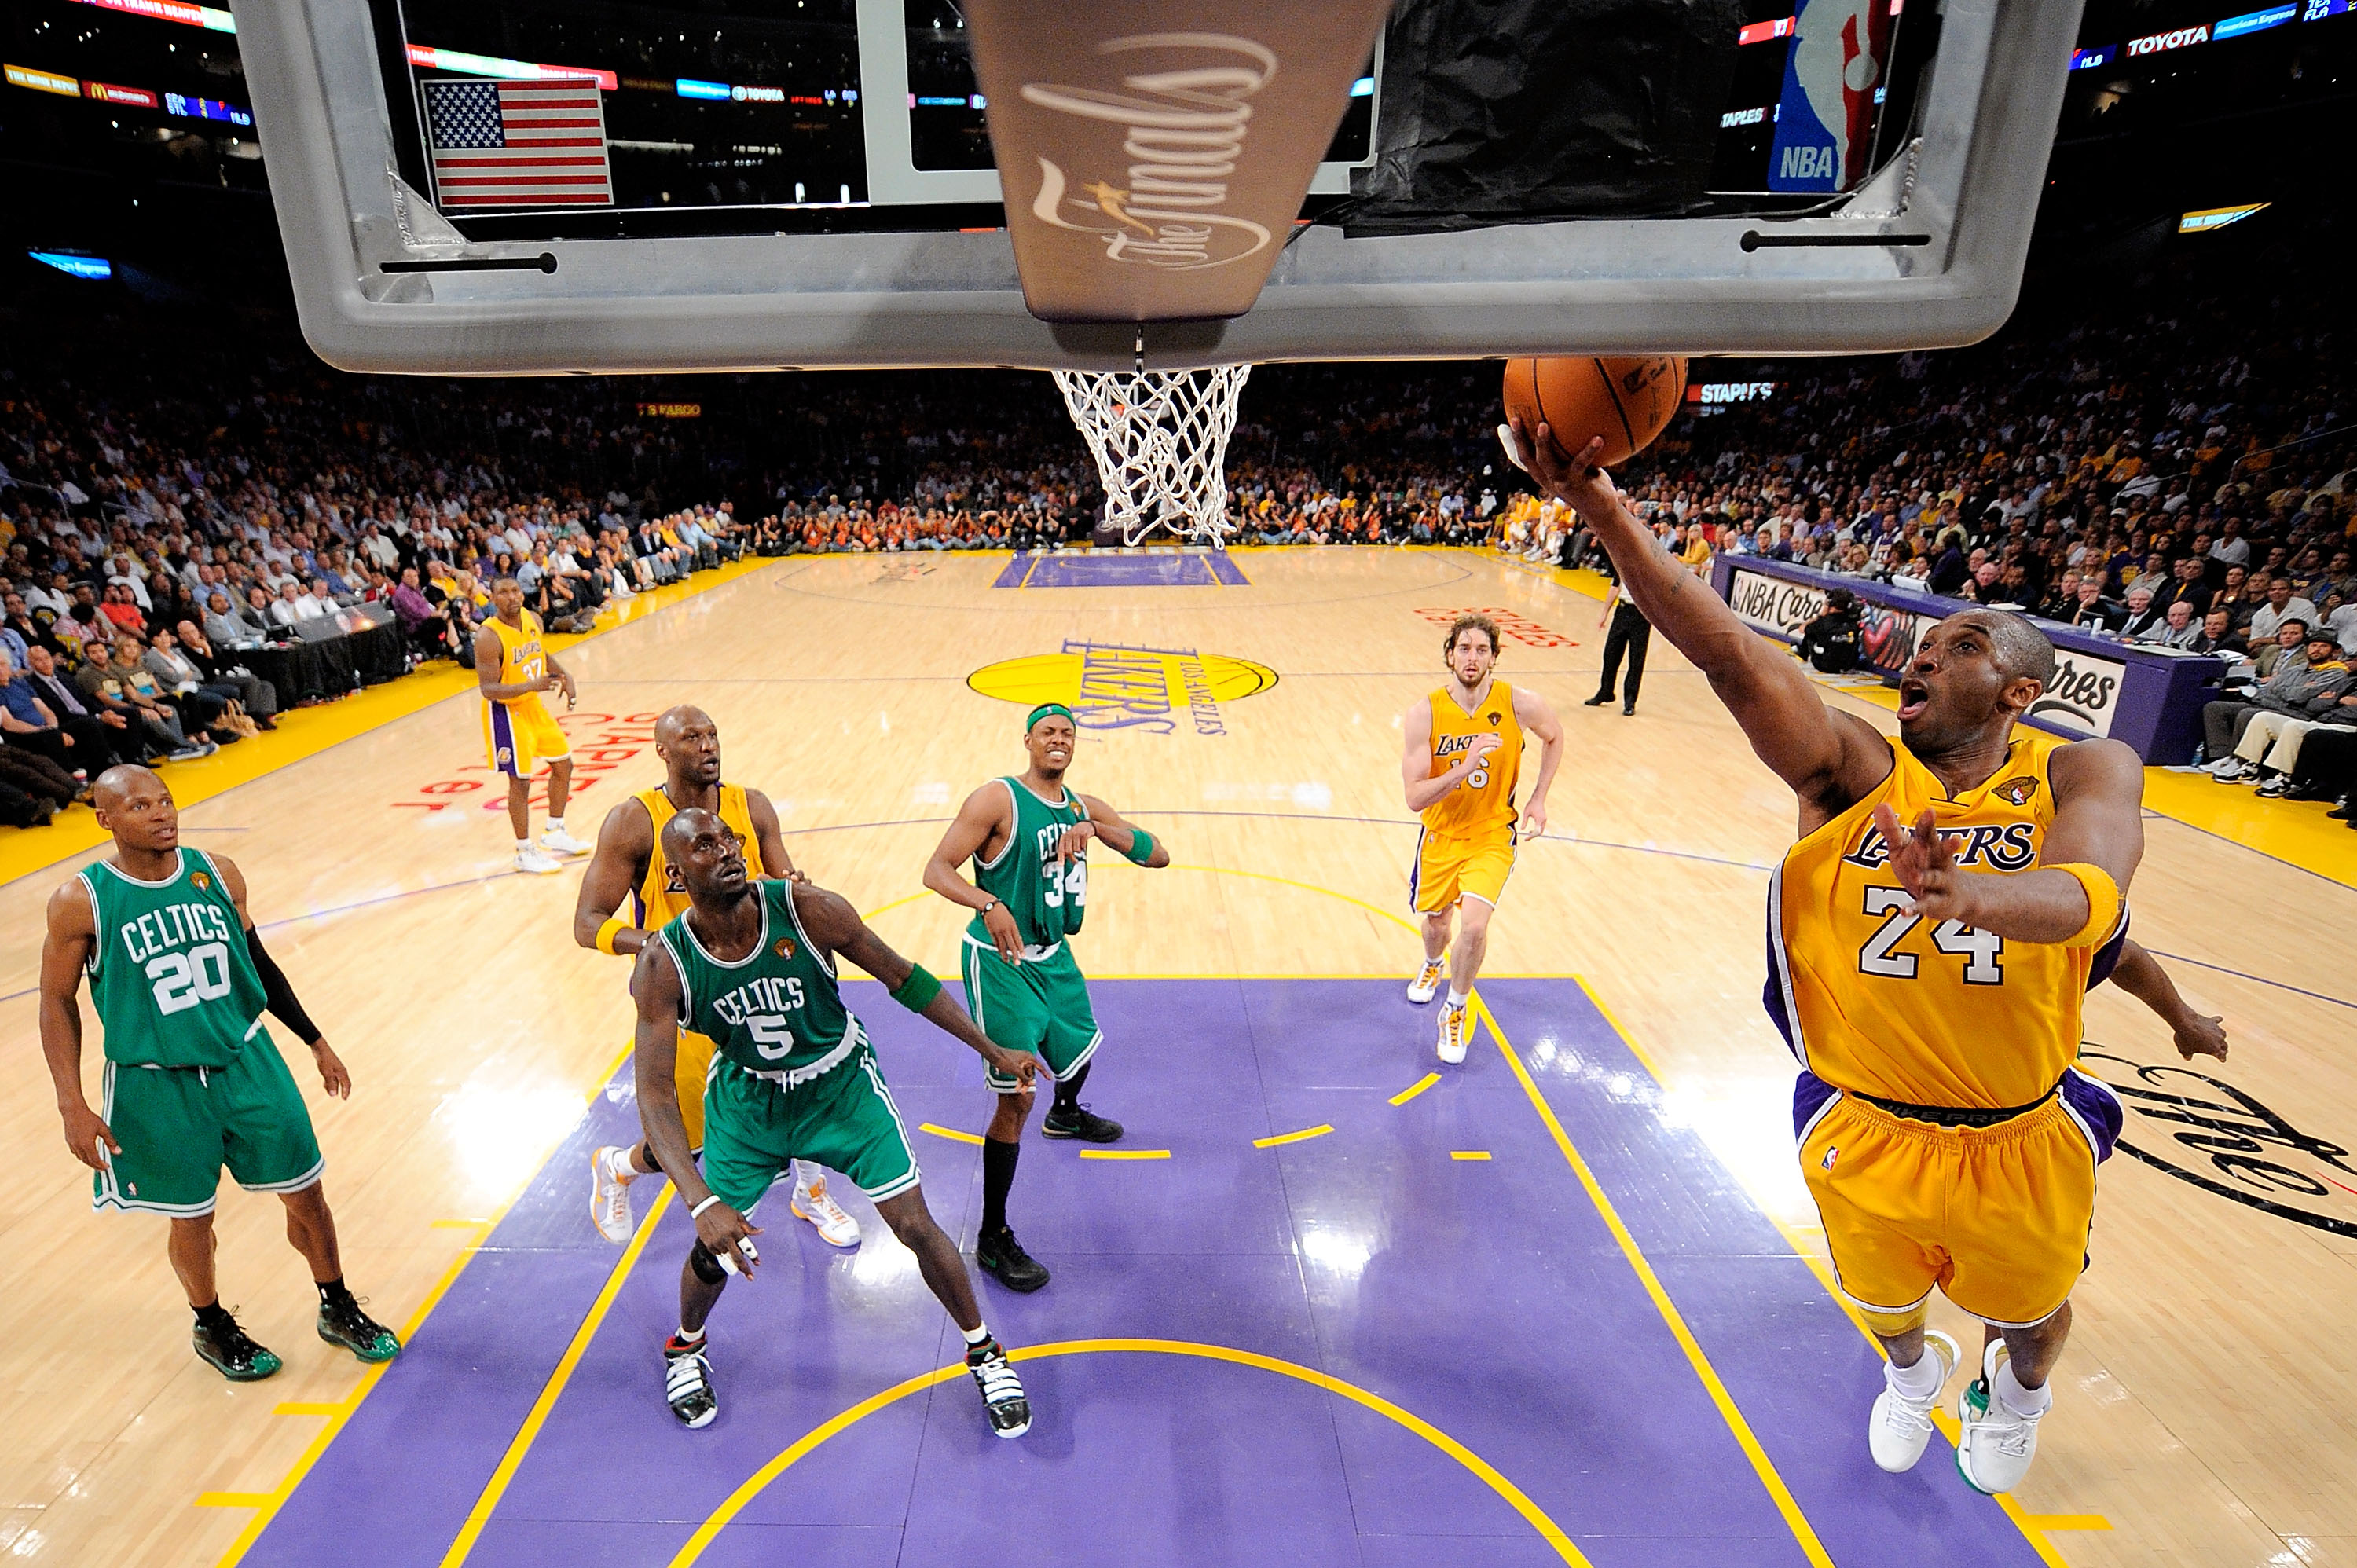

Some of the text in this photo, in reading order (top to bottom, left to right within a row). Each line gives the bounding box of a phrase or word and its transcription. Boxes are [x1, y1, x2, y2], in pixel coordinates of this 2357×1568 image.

[2215, 8, 2296, 35] American Express
[2303, 6, 2329, 22] FLA
[2080, 54, 2103, 69] MLB
[2128, 26, 2209, 57] TOYOTA
[747, 87, 785, 101] TOYOTA
[1720, 107, 1764, 128] TAPLES
[1021, 33, 1277, 270] The Finals
[1780, 146, 1832, 178] NBA
[1739, 581, 1823, 627] NBA Care
[522, 657, 543, 681] 37
[1179, 661, 1227, 736] LOS ANGELES
[1037, 822, 1087, 860] CELT
[1843, 814, 2037, 873] LAERS
[1042, 860, 1088, 908] 34
[120, 903, 231, 964] CELTICS
[1858, 884, 2004, 986] 24
[145, 942, 231, 1017] 20
[713, 976, 805, 1026] CELTICS
[747, 1014, 794, 1061] 5
[1877, 1102, 1941, 1122] NIKE
